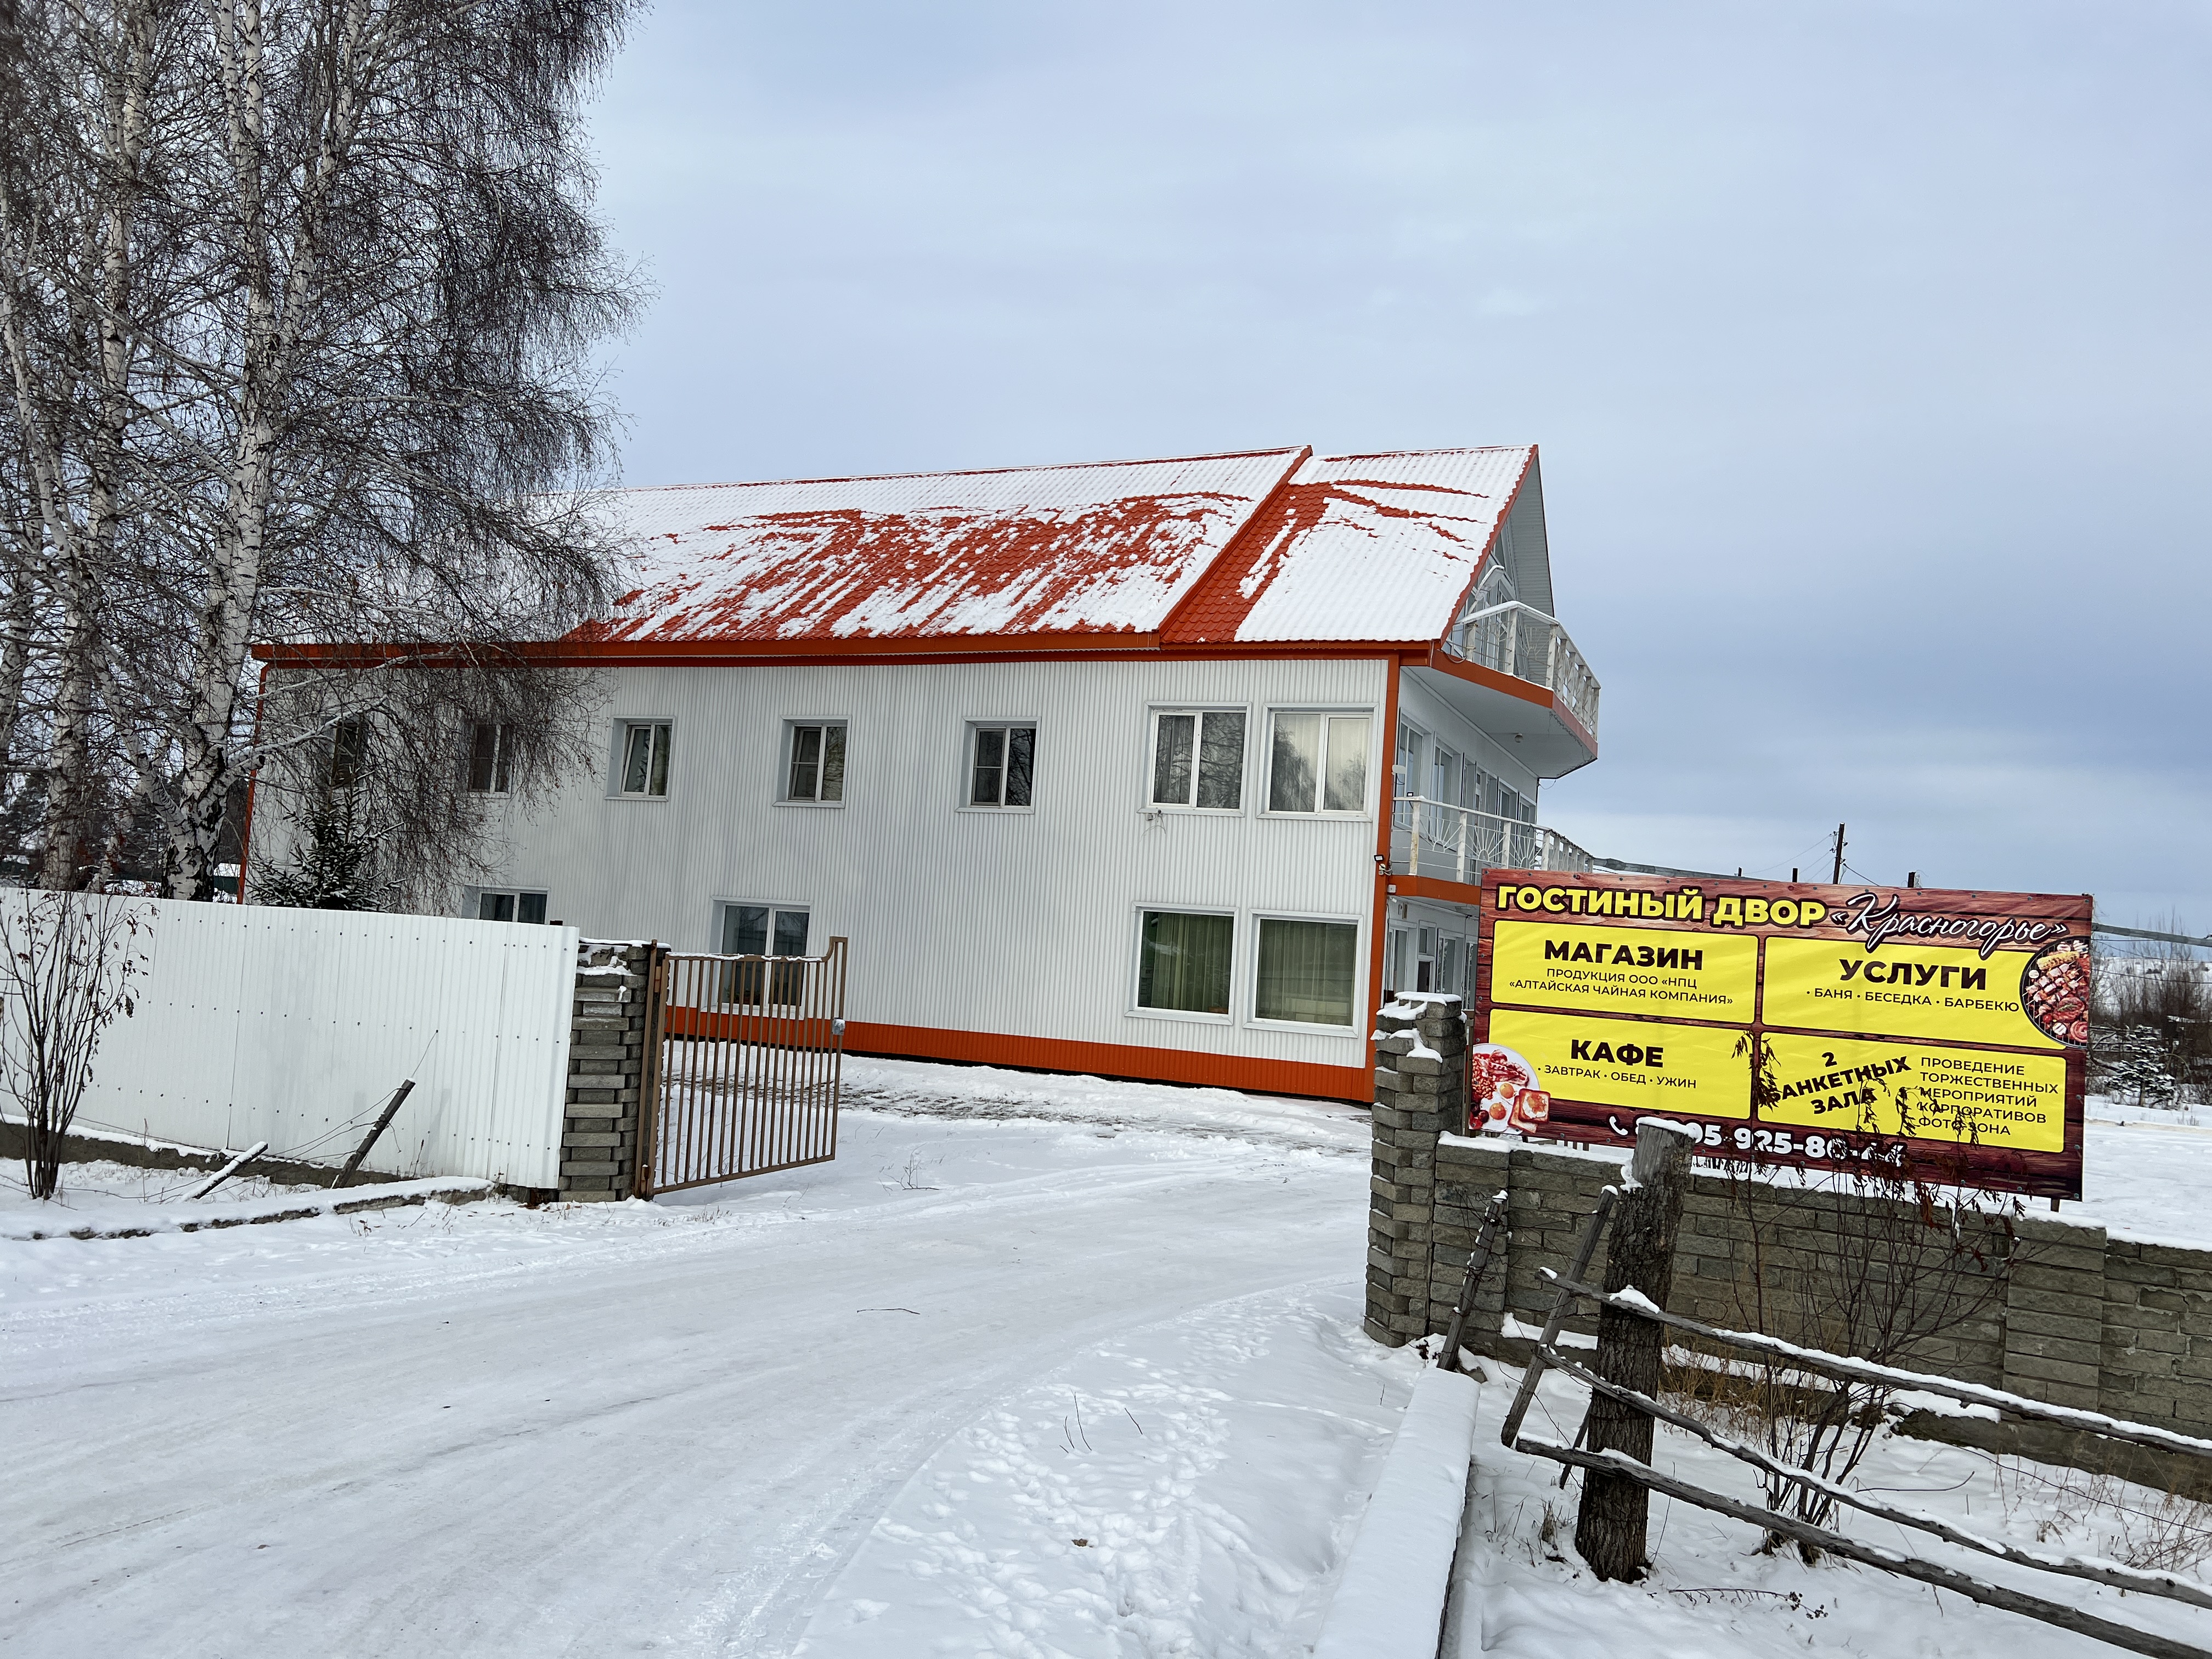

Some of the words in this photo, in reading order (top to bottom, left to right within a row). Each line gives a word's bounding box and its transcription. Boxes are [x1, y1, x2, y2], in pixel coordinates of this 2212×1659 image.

[1498, 885, 1703, 919] ГОСТИНЫЙ
[1713, 897, 1825, 926] ДВОР
[1544, 939, 1703, 970] МАГАЗИН
[1547, 968, 1625, 983] ПРОДУКЦИЯ
[1630, 974, 1658, 985] ООО
[1661, 977, 1697, 989] «НПЦ
[1838, 958, 1987, 990] УСЛУГИ
[1509, 979, 1590, 994] «АЛТАЙСКАЯ
[1593, 983, 1646, 998] ЧАЙНАЯ
[1650, 989, 1734, 1005] КОМПАНИЯ»
[1814, 987, 1853, 1000] БАНЯ
[1865, 991, 1931, 1007] БЕСЕДКА
[1944, 997, 2019, 1013] БАРБЕКЮ
[1570, 1039, 1664, 1068] КАФЕ
[1821, 1052, 1838, 1068] 2
[1544, 1064, 1601, 1080] ЗАВТРАК
[1610, 1071, 1646, 1086] ОБЕД
[1656, 1076, 1697, 1089] УЖИН
[1921, 1057, 2025, 1076] ПРОВЕДЕНИЕ
[1920, 1071, 2059, 1094] ТОРЖЕСТВЕННЫХ
[1920, 1087, 2037, 1107] МЕРОПРИЯТИЙ
[1920, 1102, 2047, 1123] КОРПОРАТИВОВ
